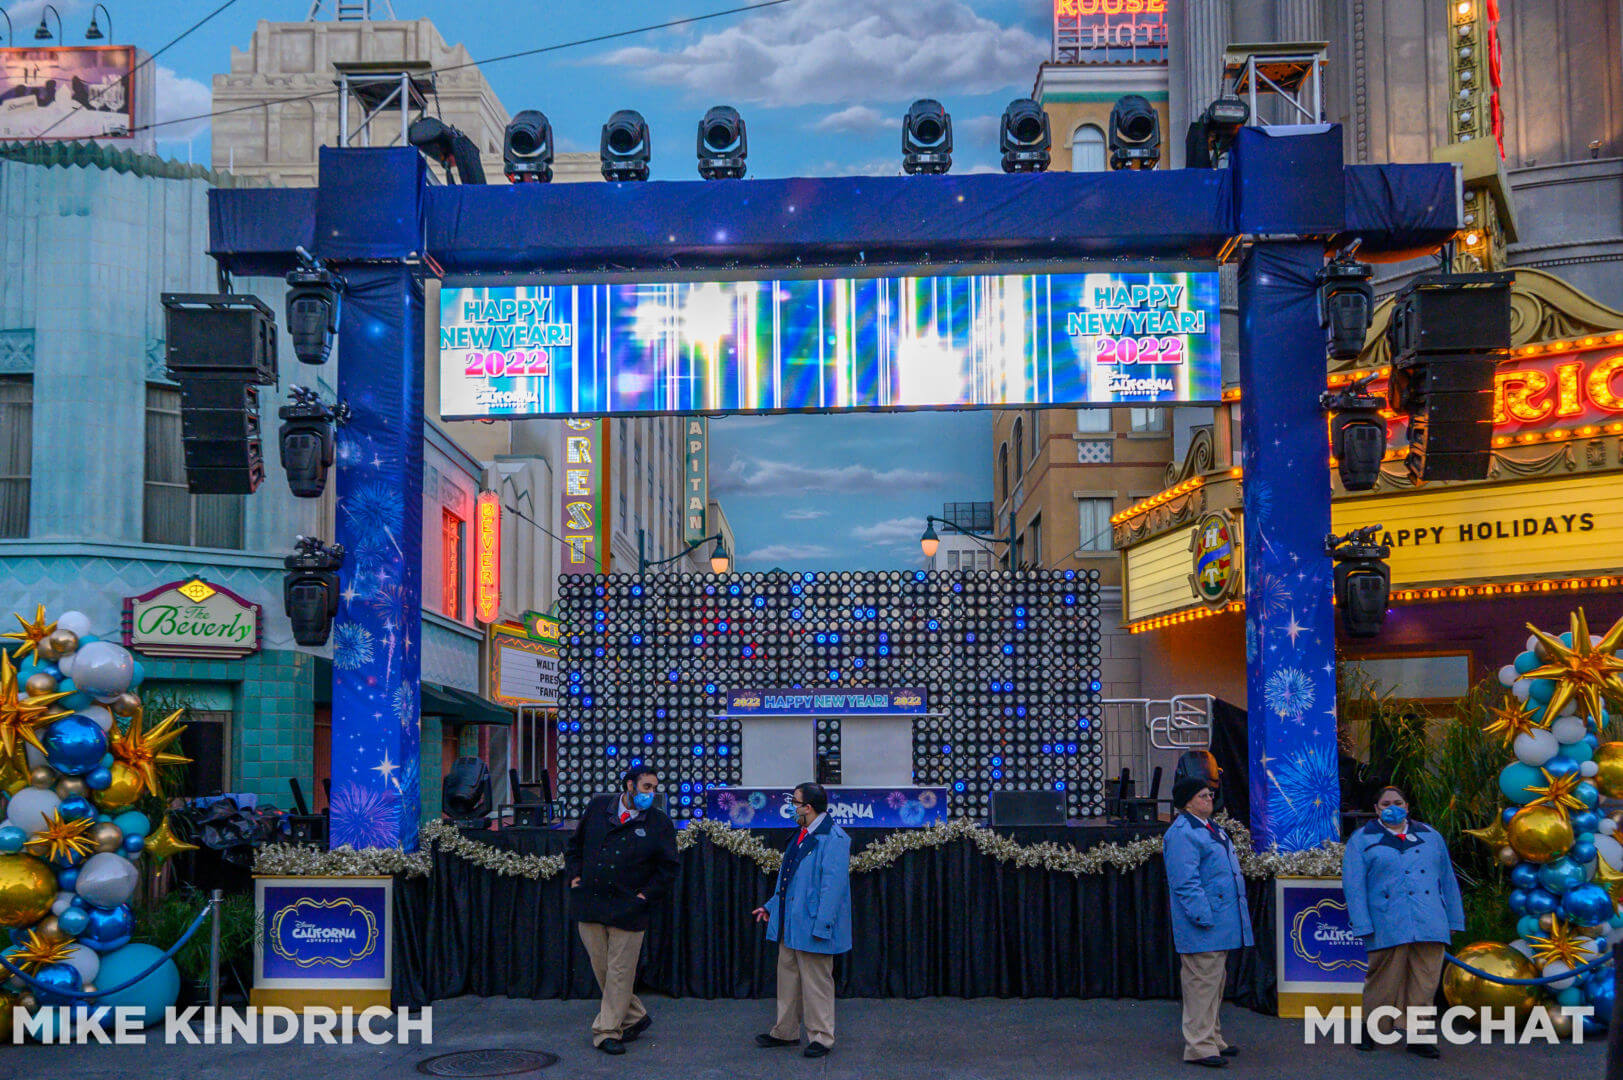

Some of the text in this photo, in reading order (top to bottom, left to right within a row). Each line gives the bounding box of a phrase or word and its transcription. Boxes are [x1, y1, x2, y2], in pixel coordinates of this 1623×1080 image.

[1092, 23, 1168, 49] HOT
[1094, 284, 1183, 309] HAPPY
[463, 298, 551, 322] HAPPY
[1068, 309, 1206, 336] NEW YEAR!
[440, 323, 572, 349] NEW YEAR!
[1096, 336, 1183, 365] 2022
[464, 350, 549, 377] 2022
[689, 421, 703, 530] APITAN
[1372, 513, 1595, 549] APPY HOLIDAYS
[480, 503, 495, 617] BEVERLY
[138, 605, 252, 643] Beverly
[184, 605, 210, 620] The
[536, 659, 555, 671] WALT
[733, 694, 922, 708] 2022 HAPPY NEW YEAR! 2022
[292, 927, 357, 939] CALIFORNIA
[294, 920, 316, 929] Disney
[1314, 930, 1356, 941] CALIFO
[1316, 921, 1339, 931] Disney
